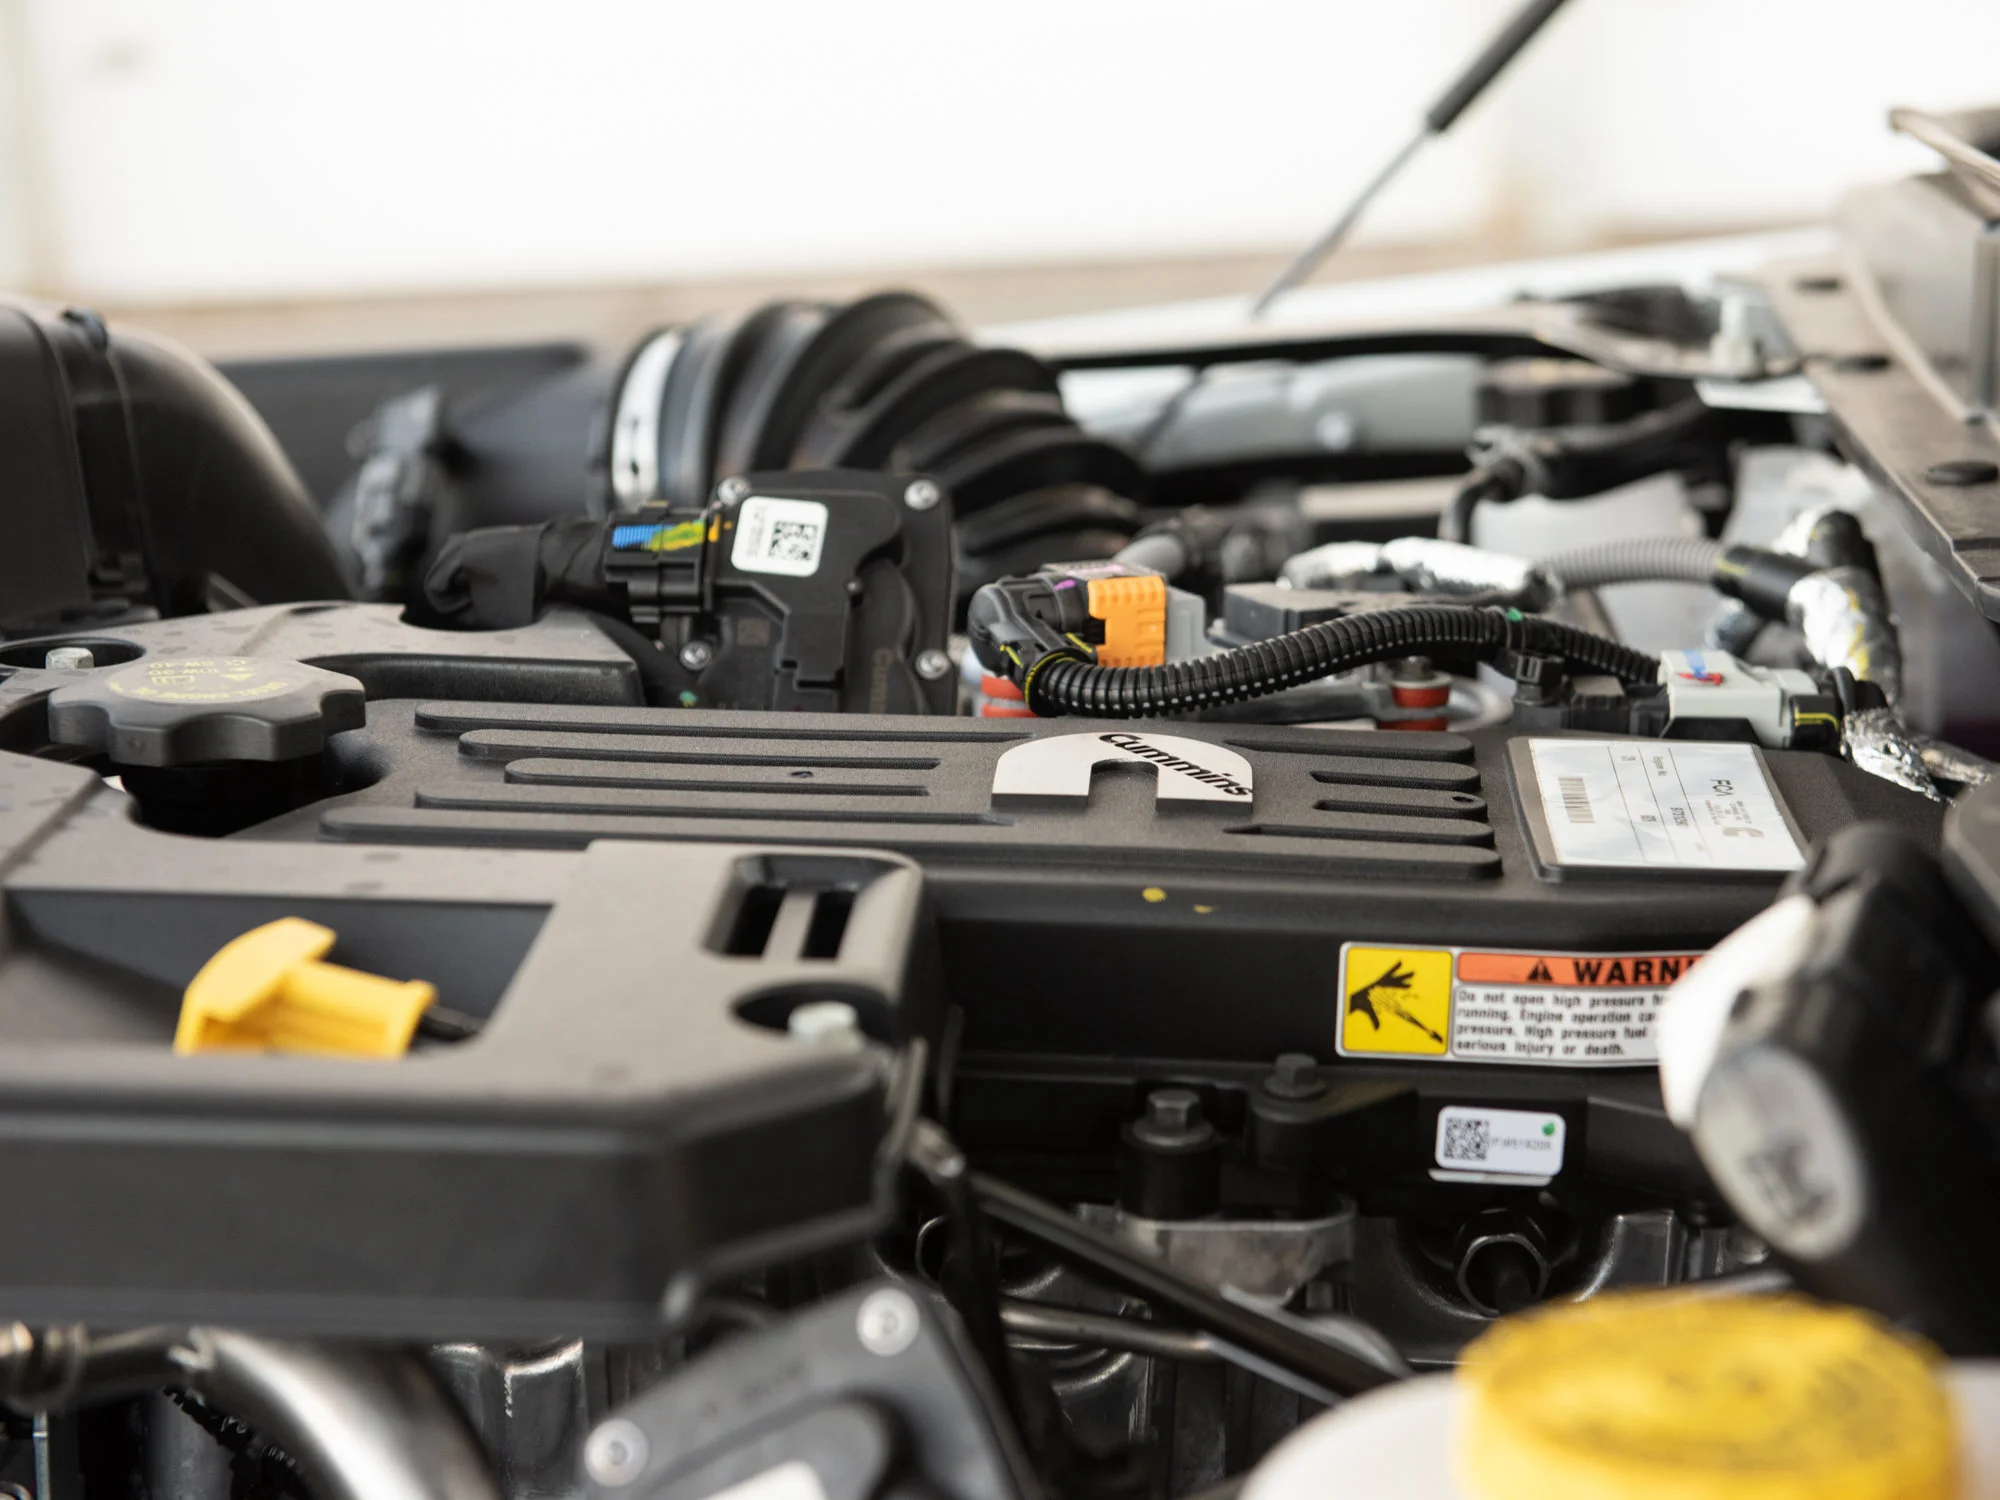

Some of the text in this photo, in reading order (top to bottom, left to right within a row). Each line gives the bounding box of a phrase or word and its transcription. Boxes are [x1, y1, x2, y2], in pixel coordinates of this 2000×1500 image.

[1099, 733, 1252, 796] Cummins
[1710, 778, 1735, 797] FCA
[1458, 990, 1475, 1001] Do
[1483, 992, 1505, 1002] not
[1513, 994, 1545, 1005] open
[1553, 994, 1582, 1009] high
[1589, 996, 1645, 1009] pressure
[1458, 1008, 1512, 1022] running.
[1520, 1008, 1563, 1023] Engine
[1572, 1012, 1632, 1024] operation
[1525, 1025, 1554, 1039] High
[1562, 1027, 1617, 1040] pressure
[1623, 1026, 1648, 1039] fuel
[1457, 1041, 1625, 1057] serious injury or death.
